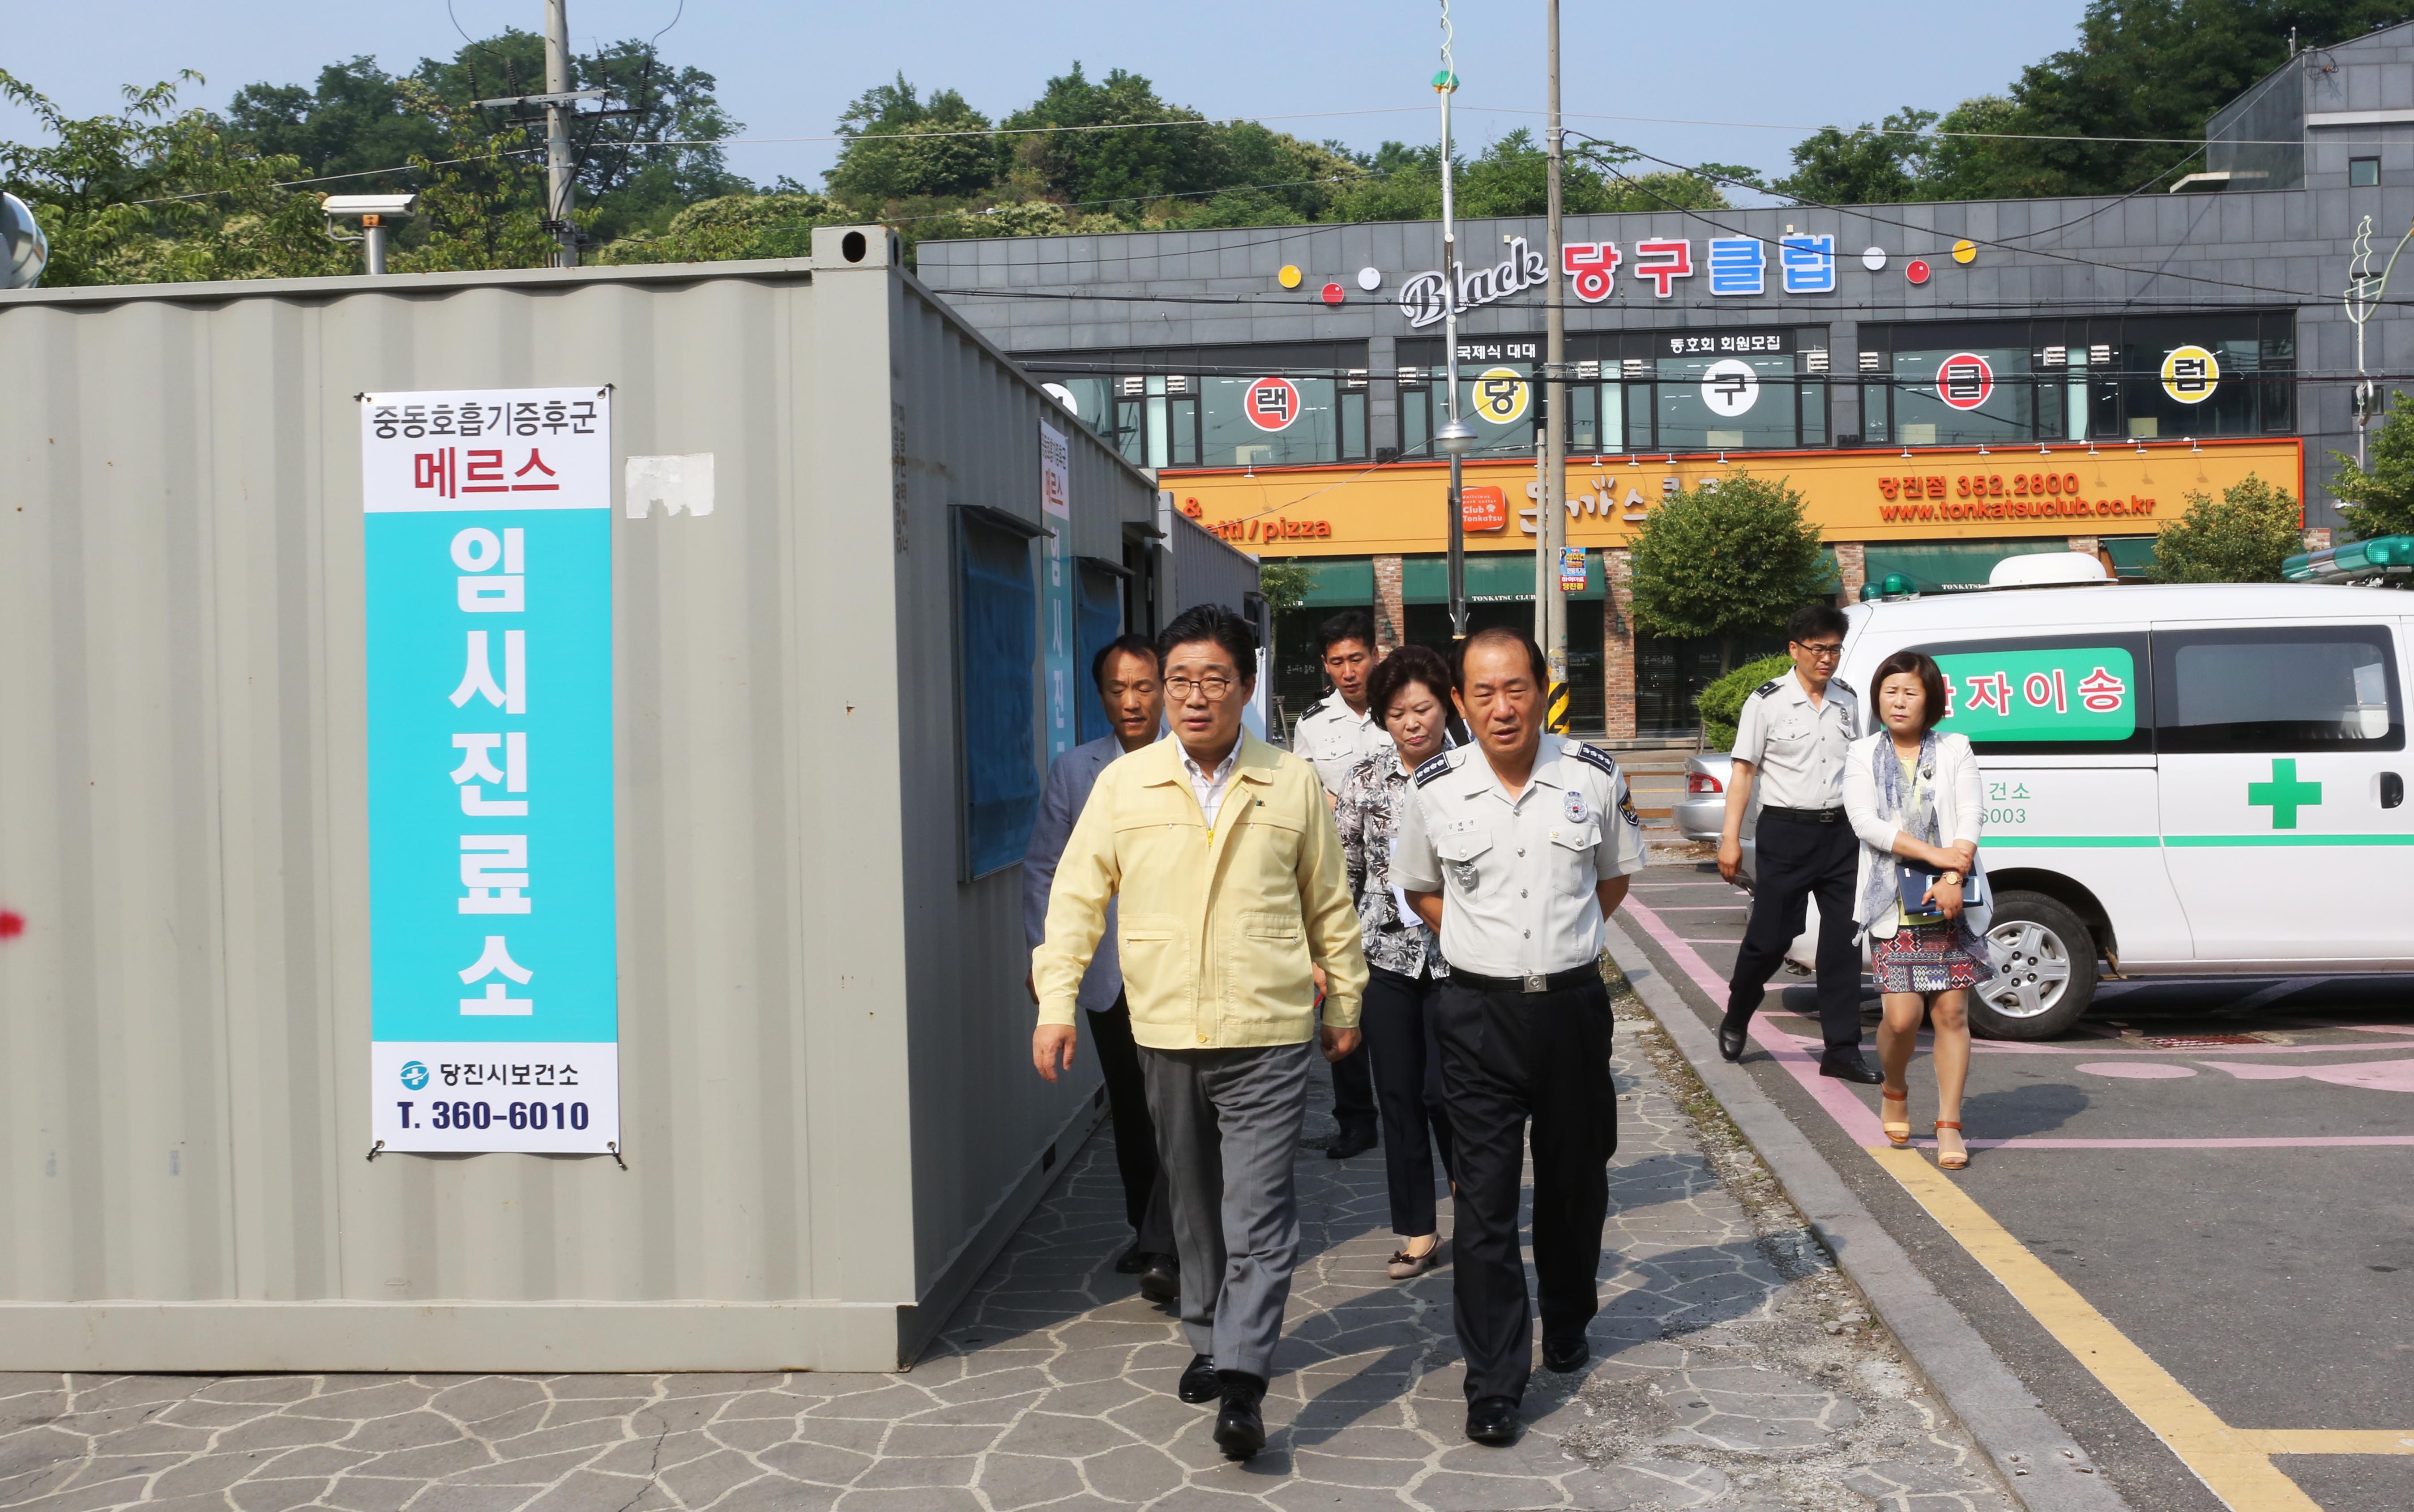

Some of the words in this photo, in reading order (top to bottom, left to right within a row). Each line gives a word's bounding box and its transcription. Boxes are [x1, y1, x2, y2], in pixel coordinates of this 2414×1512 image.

[1562, 234, 1835, 303] 당구클럽
[1457, 344, 1500, 360] 국제식
[1507, 343, 1535, 358] 대대
[1671, 337, 1714, 354] 동호회
[1721, 335, 1780, 351] 회원모집
[1256, 387, 1288, 421] 랙
[1483, 378, 1521, 416] 당
[1714, 374, 1746, 406] 구
[1948, 364, 1982, 400] 클
[2174, 358, 2206, 393] 럽
[373, 401, 597, 439] 중동호흡기증후군
[414, 447, 559, 499] 메르스
[1878, 475, 1946, 499] 당진점
[1957, 473, 2080, 496] 352.2800
[1462, 506, 1484, 514] Club
[1462, 514, 1503, 522] Tonkatsu
[1879, 495, 2156, 521] www.tonkatsuclub.co.kr
[1262, 517, 1332, 543] pizza
[448, 527, 534, 1016] 임시진료소
[440, 1064, 578, 1086] 당진시보건소
[397, 1102, 420, 1129] T.
[432, 1101, 589, 1130] 360-6010
